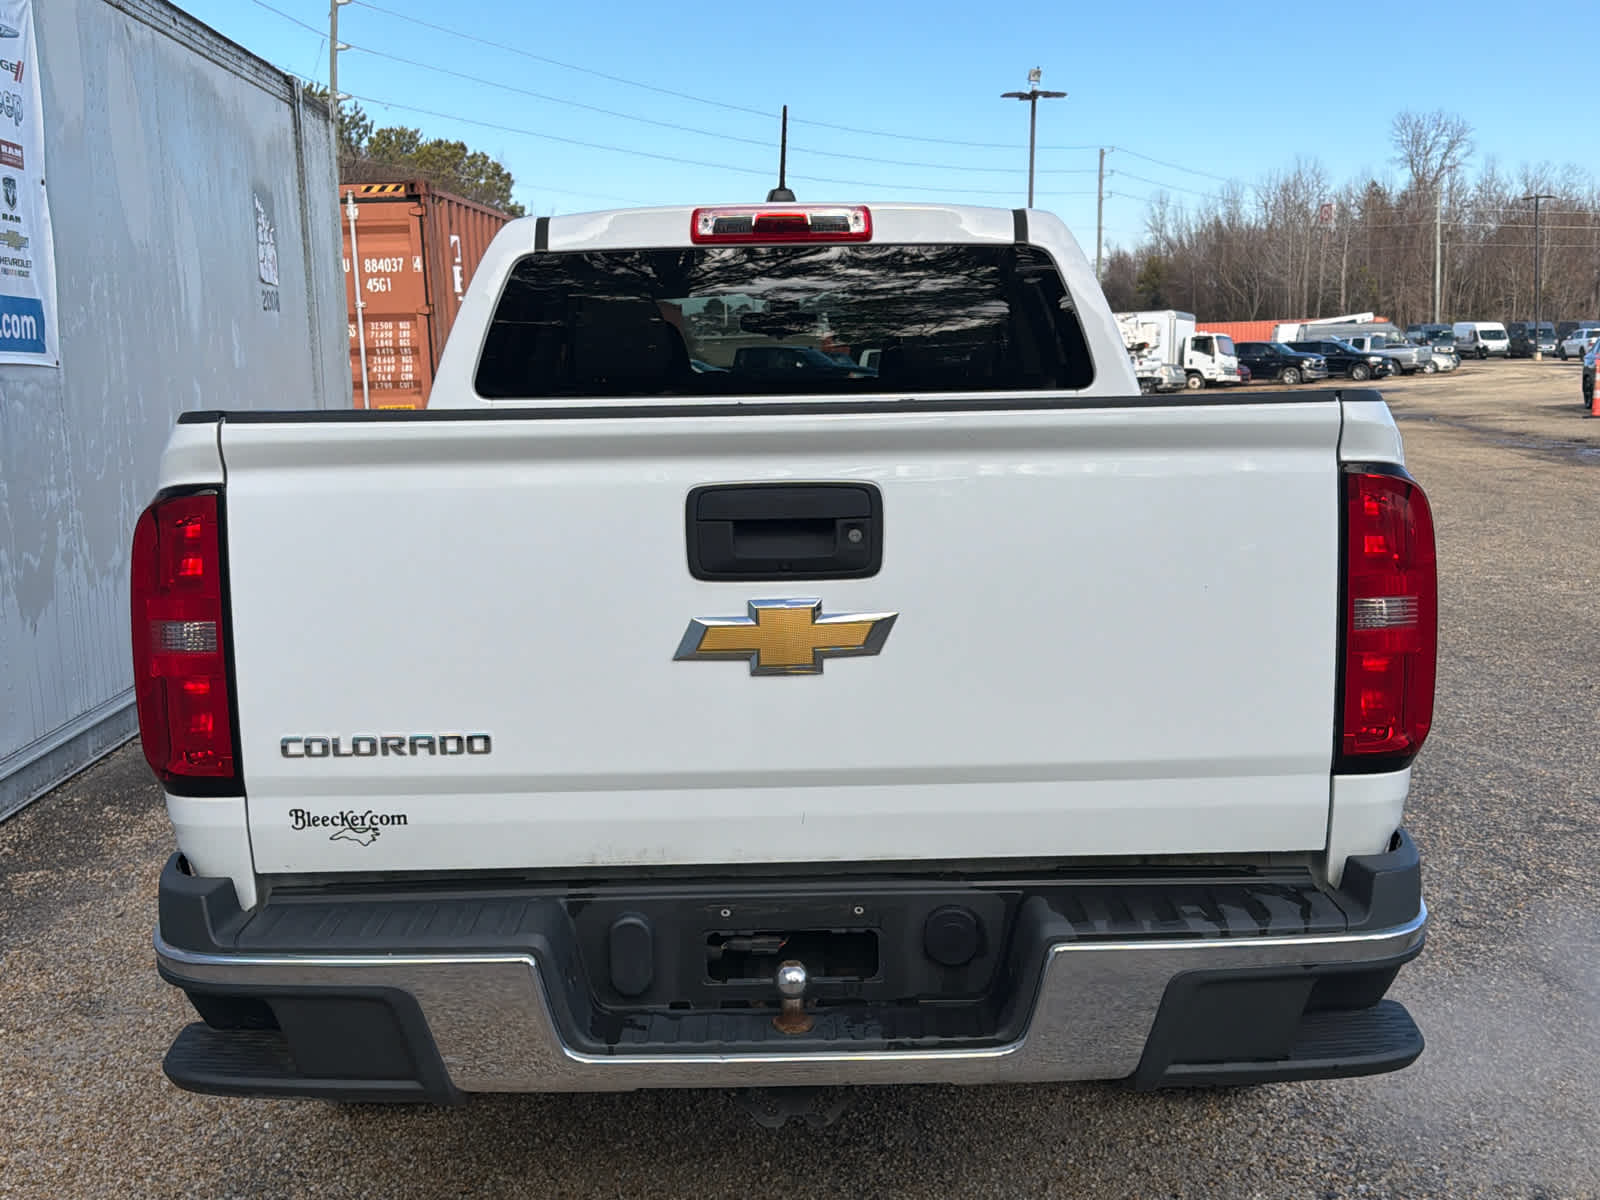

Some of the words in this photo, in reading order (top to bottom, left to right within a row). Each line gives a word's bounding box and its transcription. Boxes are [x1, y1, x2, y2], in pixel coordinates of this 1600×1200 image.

[2, 213, 21, 223] RAM
[364, 258, 404, 273] 884037
[413, 256, 422, 272] 4
[366, 278, 392, 292] 45G1
[281, 734, 492, 758] COLORADO
